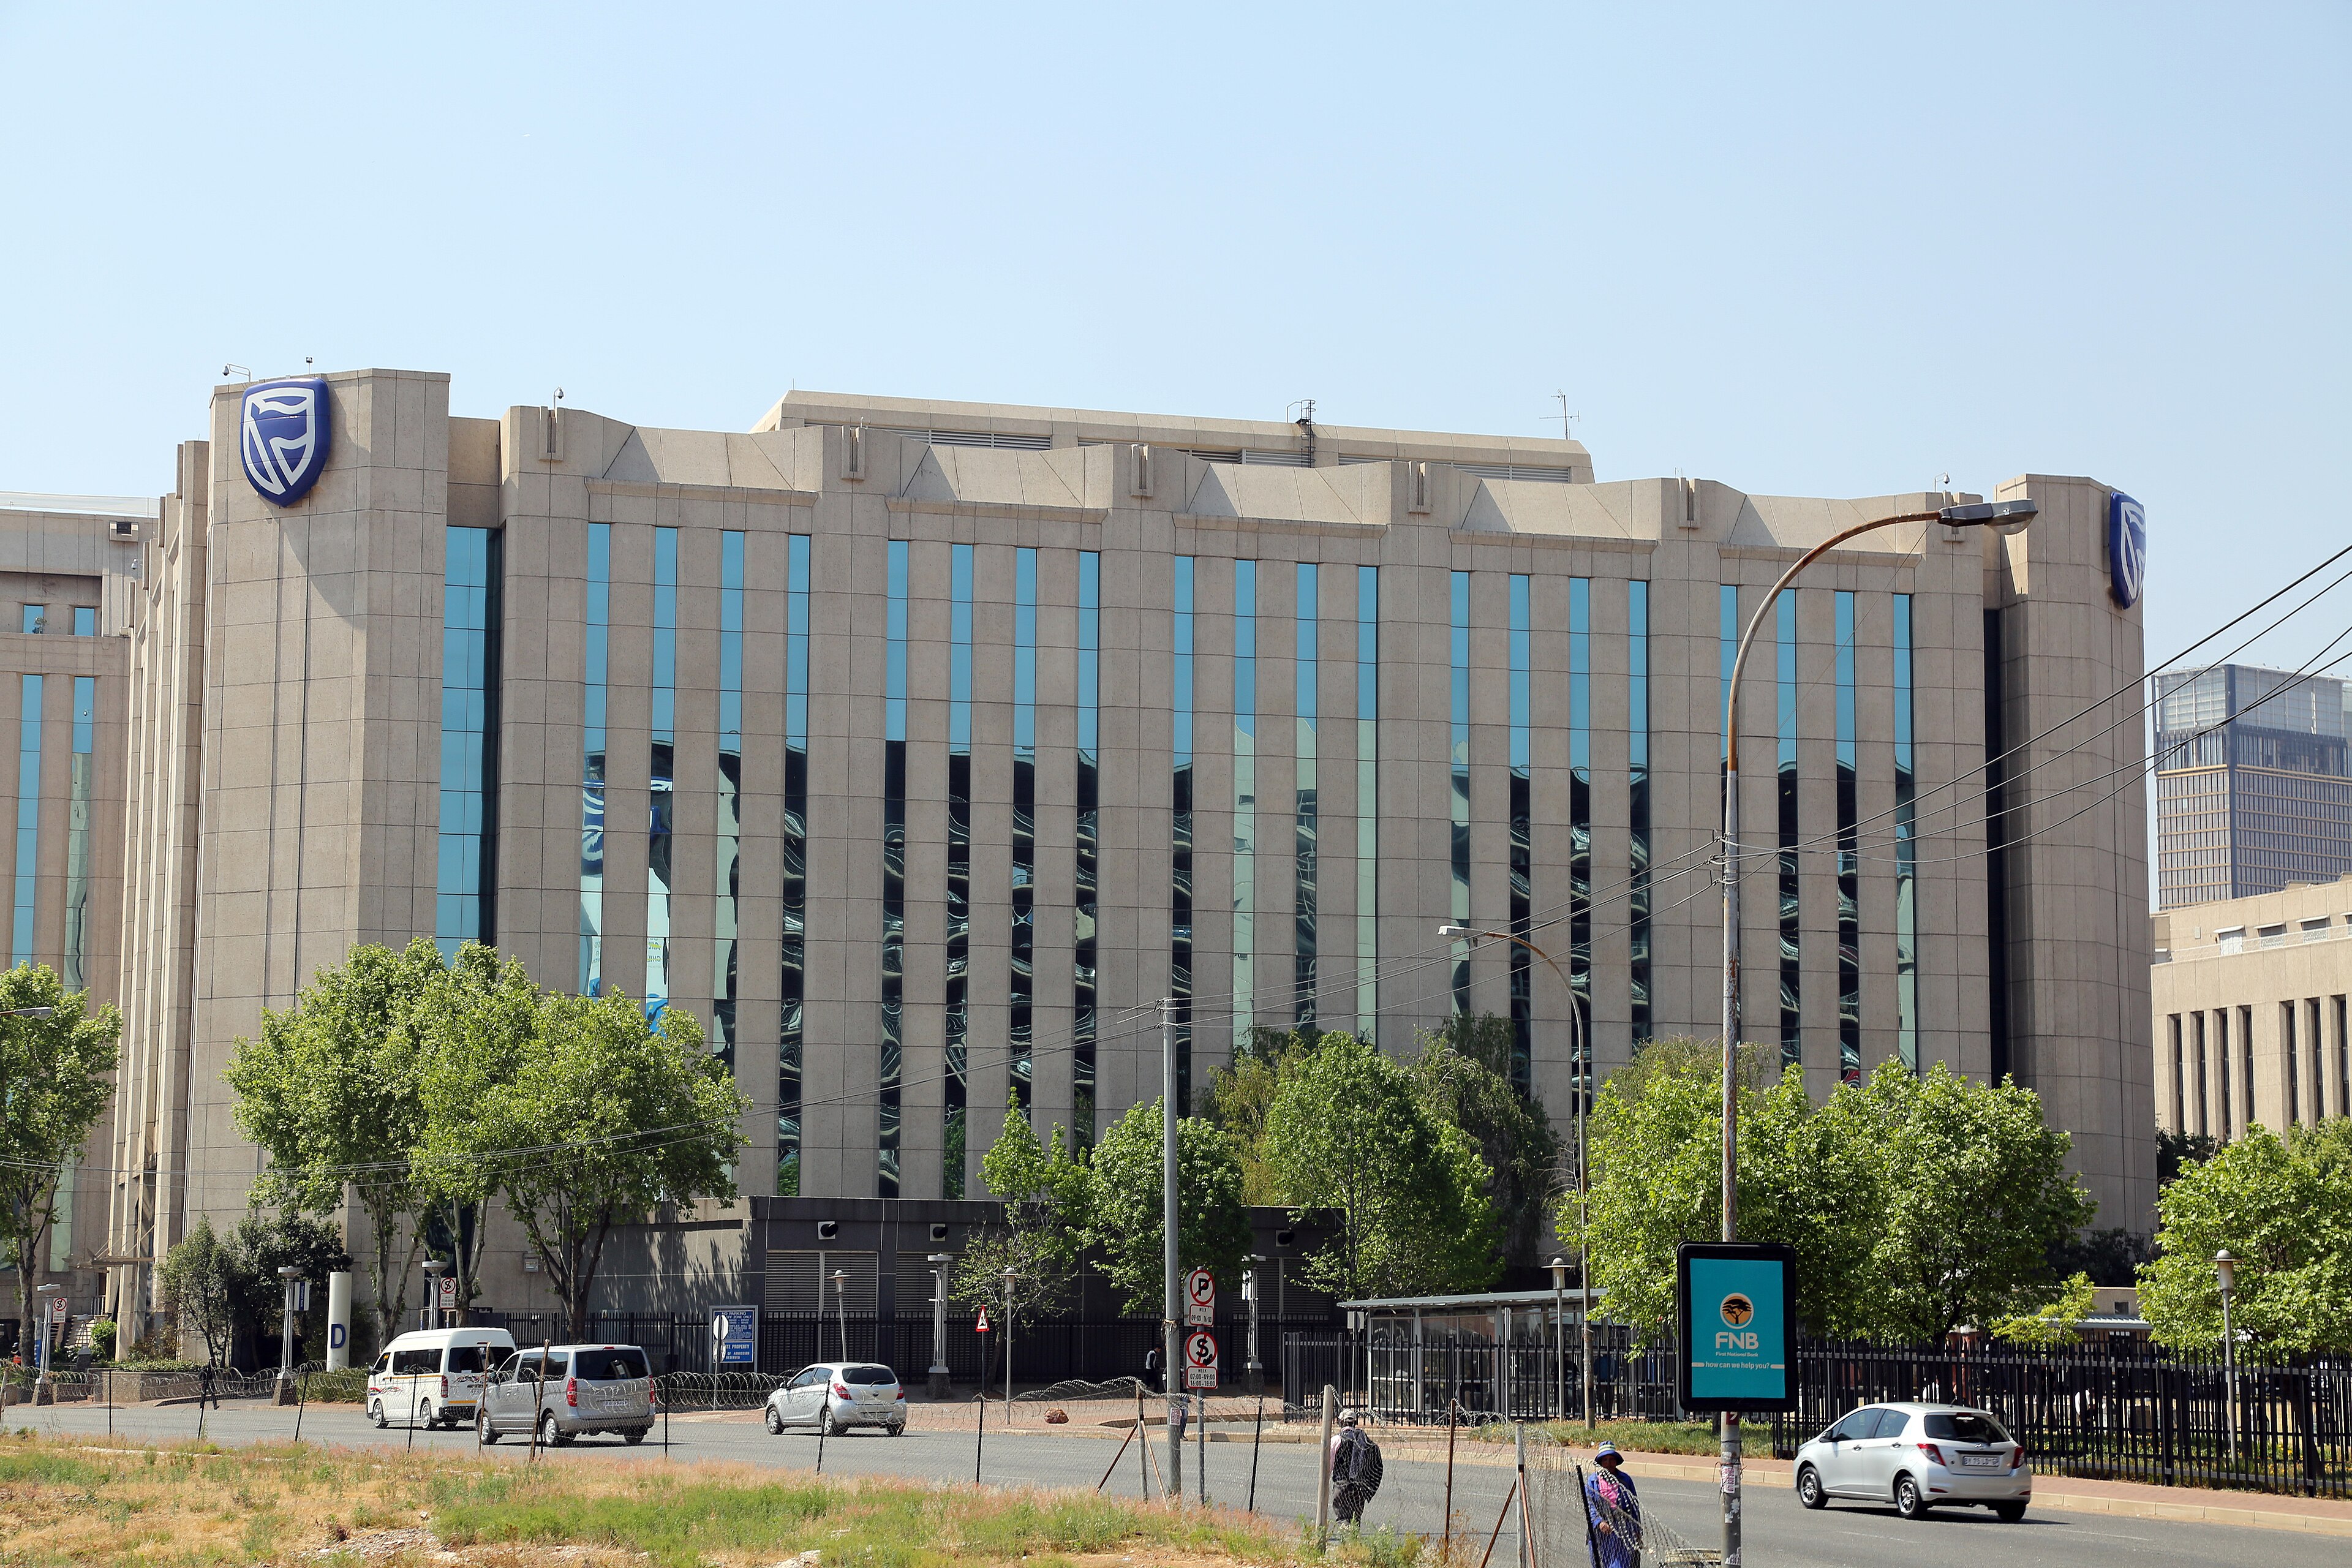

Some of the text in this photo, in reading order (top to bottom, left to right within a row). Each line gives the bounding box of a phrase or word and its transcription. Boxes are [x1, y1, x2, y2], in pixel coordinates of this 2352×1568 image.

[1198, 1278, 1209, 1296] P
[331, 1324, 346, 1349] D
[1716, 1332, 1759, 1349] FNB
[1196, 1338, 1209, 1357] S
